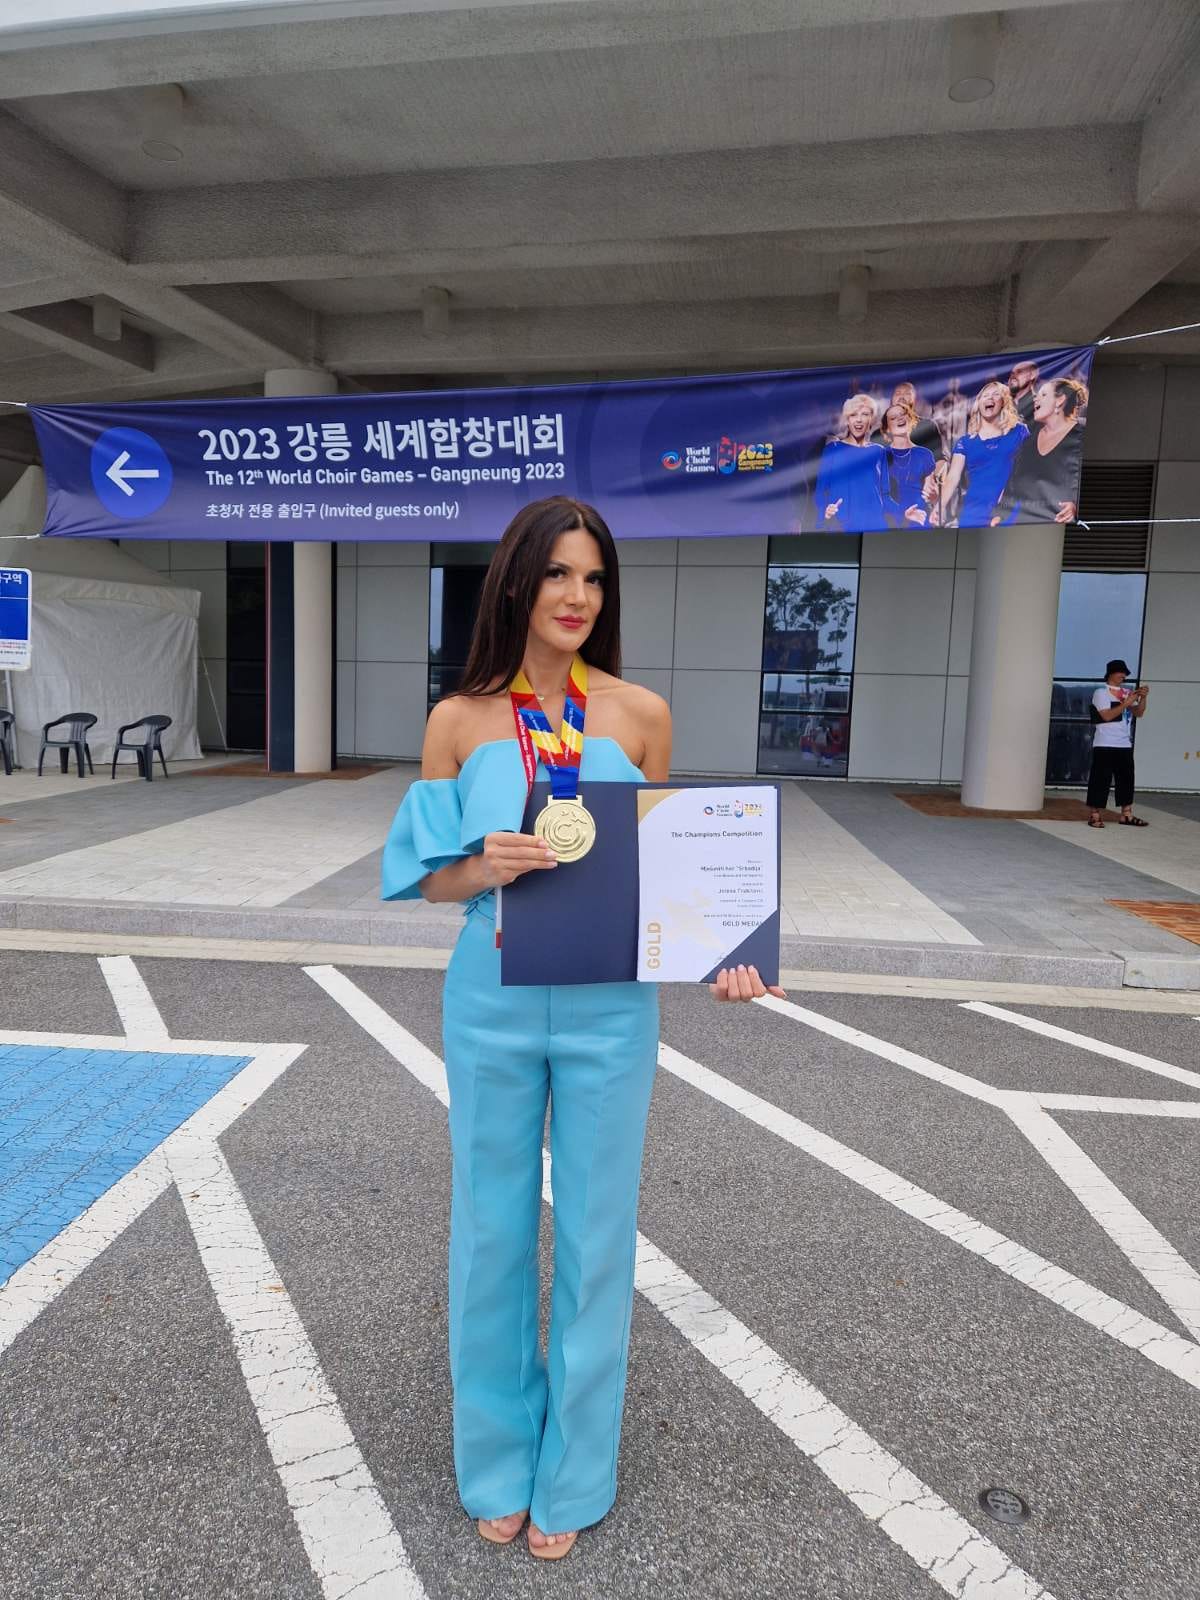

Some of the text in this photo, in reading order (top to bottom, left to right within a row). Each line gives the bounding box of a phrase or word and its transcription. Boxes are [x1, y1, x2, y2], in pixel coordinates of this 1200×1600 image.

[198, 413, 565, 462] 2023 강릉 세계합창대회
[686, 446, 711, 455] World
[686, 455, 711, 464] Choir
[206, 470, 234, 486] The
[238, 469, 264, 486] 12th
[266, 468, 312, 485] World
[315, 468, 358, 484] Choir
[360, 467, 414, 484] Games
[430, 465, 521, 485] Gangneung
[525, 462, 565, 480] 2023
[686, 464, 716, 473] Games
[205, 501, 459, 520] 초청자 전용 출입구 (Invited guests only)
[0, 573, 22, 585] 구역
[684, 831, 721, 839] Champions
[722, 830, 763, 839] Competition
[647, 922, 661, 970] GOLD
